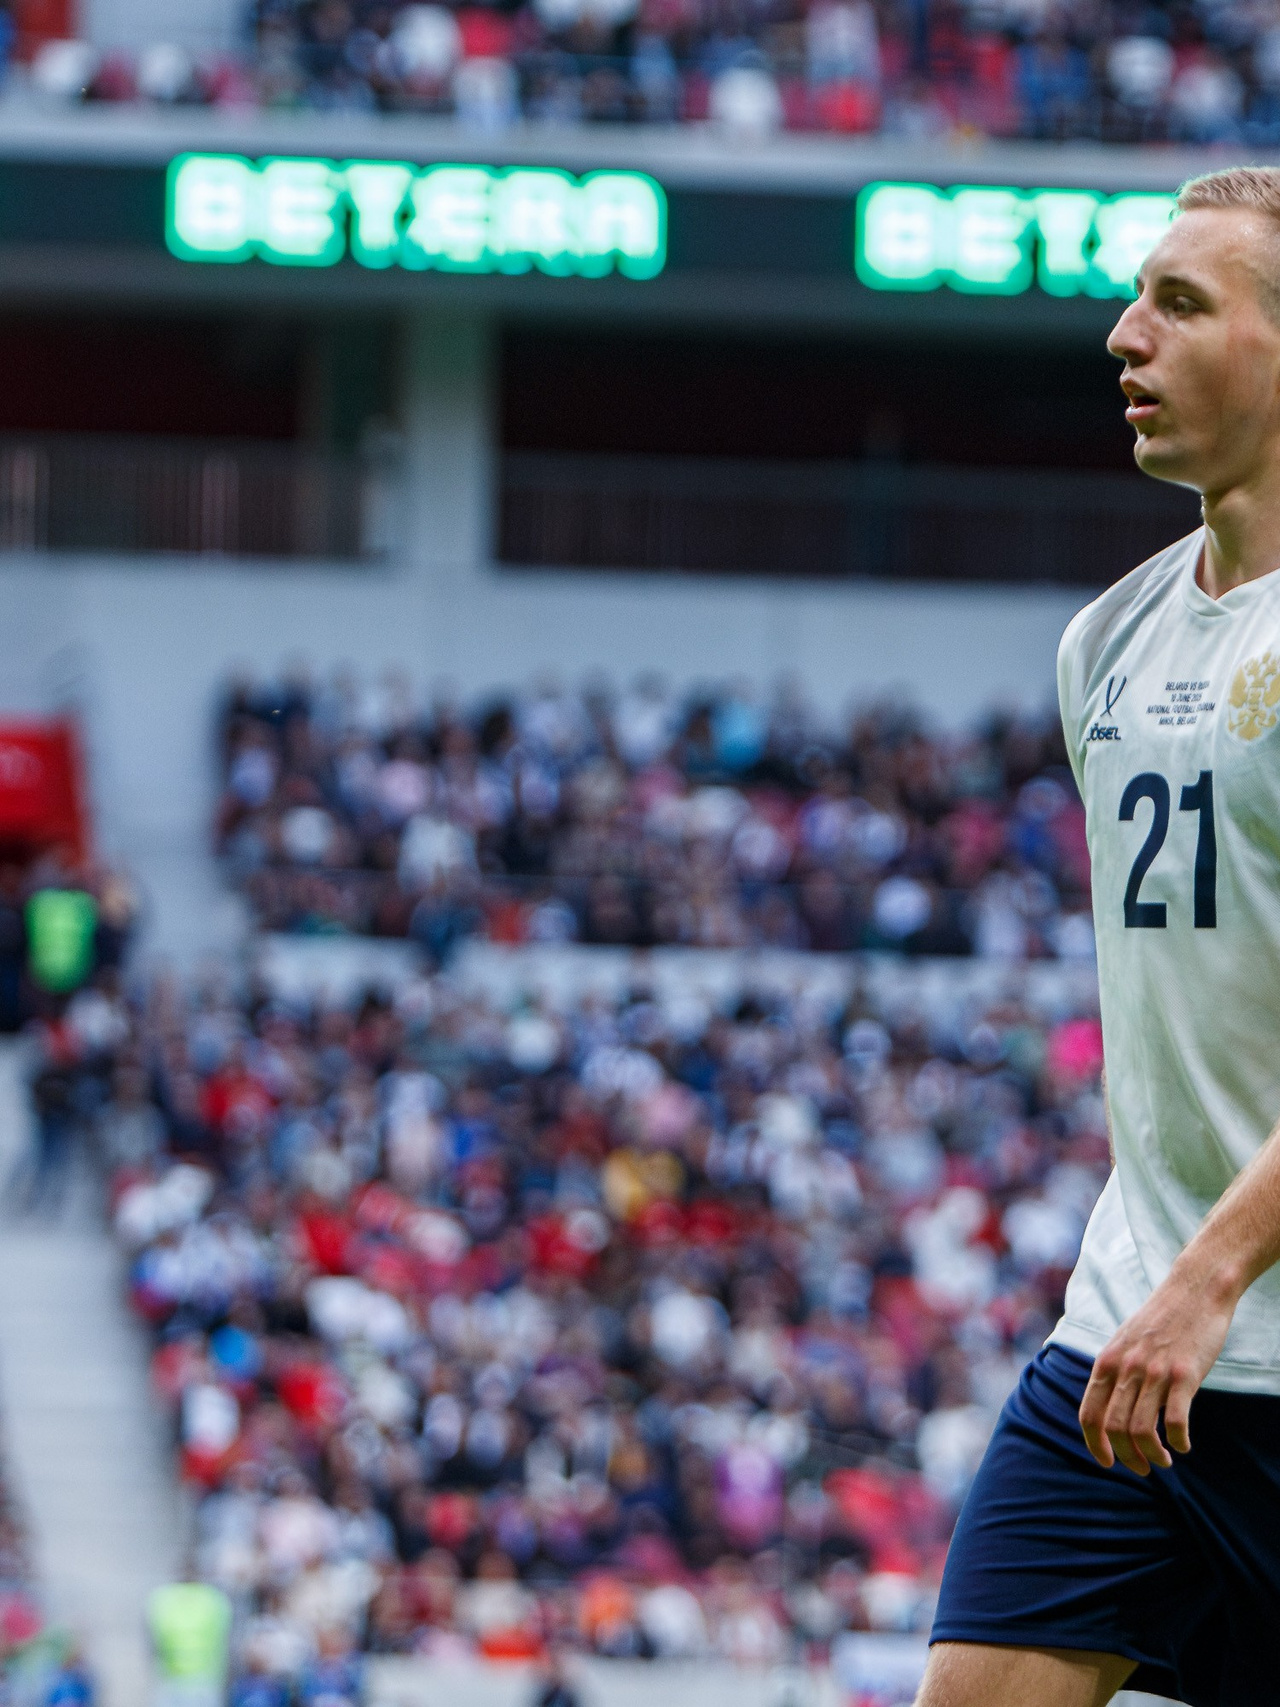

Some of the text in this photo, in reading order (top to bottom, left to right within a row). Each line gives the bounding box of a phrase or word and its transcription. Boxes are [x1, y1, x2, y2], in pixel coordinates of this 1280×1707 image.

[166, 152, 668, 280] BETERA
[855, 181, 1186, 300] BETE
[1118, 770, 1217, 928] 21
